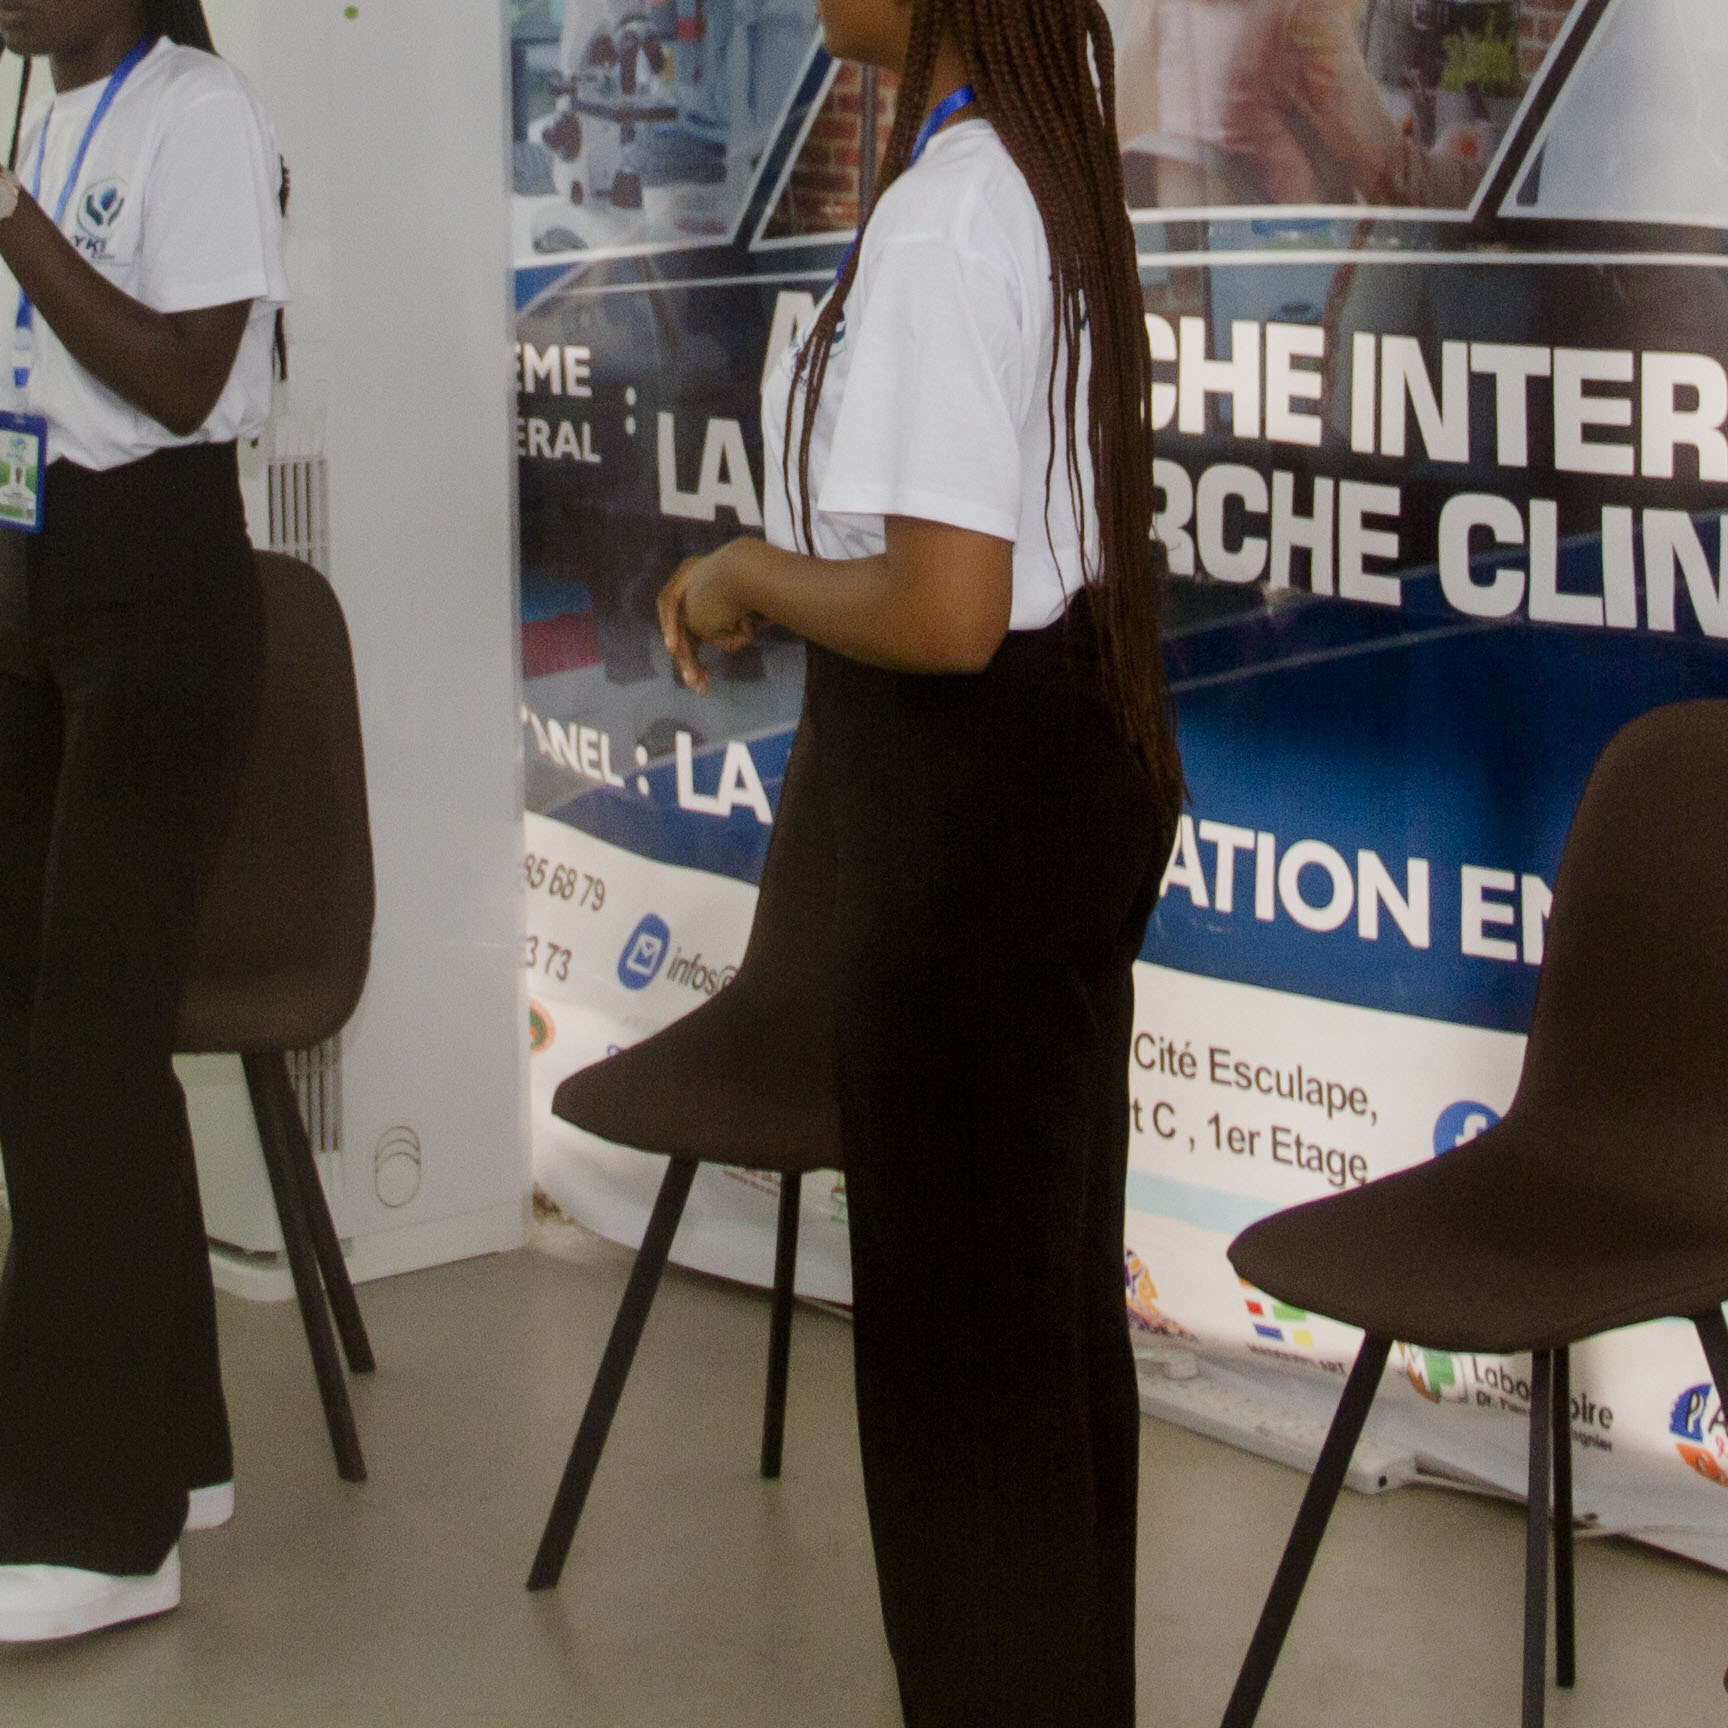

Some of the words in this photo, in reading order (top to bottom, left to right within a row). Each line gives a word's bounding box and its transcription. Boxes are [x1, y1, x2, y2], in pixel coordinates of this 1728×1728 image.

[656, 412, 765, 527] LA
[676, 730, 773, 825] LA
[580, 872, 606, 912] 79
[545, 940, 572, 983] 73
[1134, 1031, 1197, 1080] Cité
[1208, 1045, 1379, 1128] Esculape,
[1152, 1101, 1177, 1140] C
[1207, 1111, 1262, 1157] 1er
[1271, 1124, 1368, 1189] Etage
